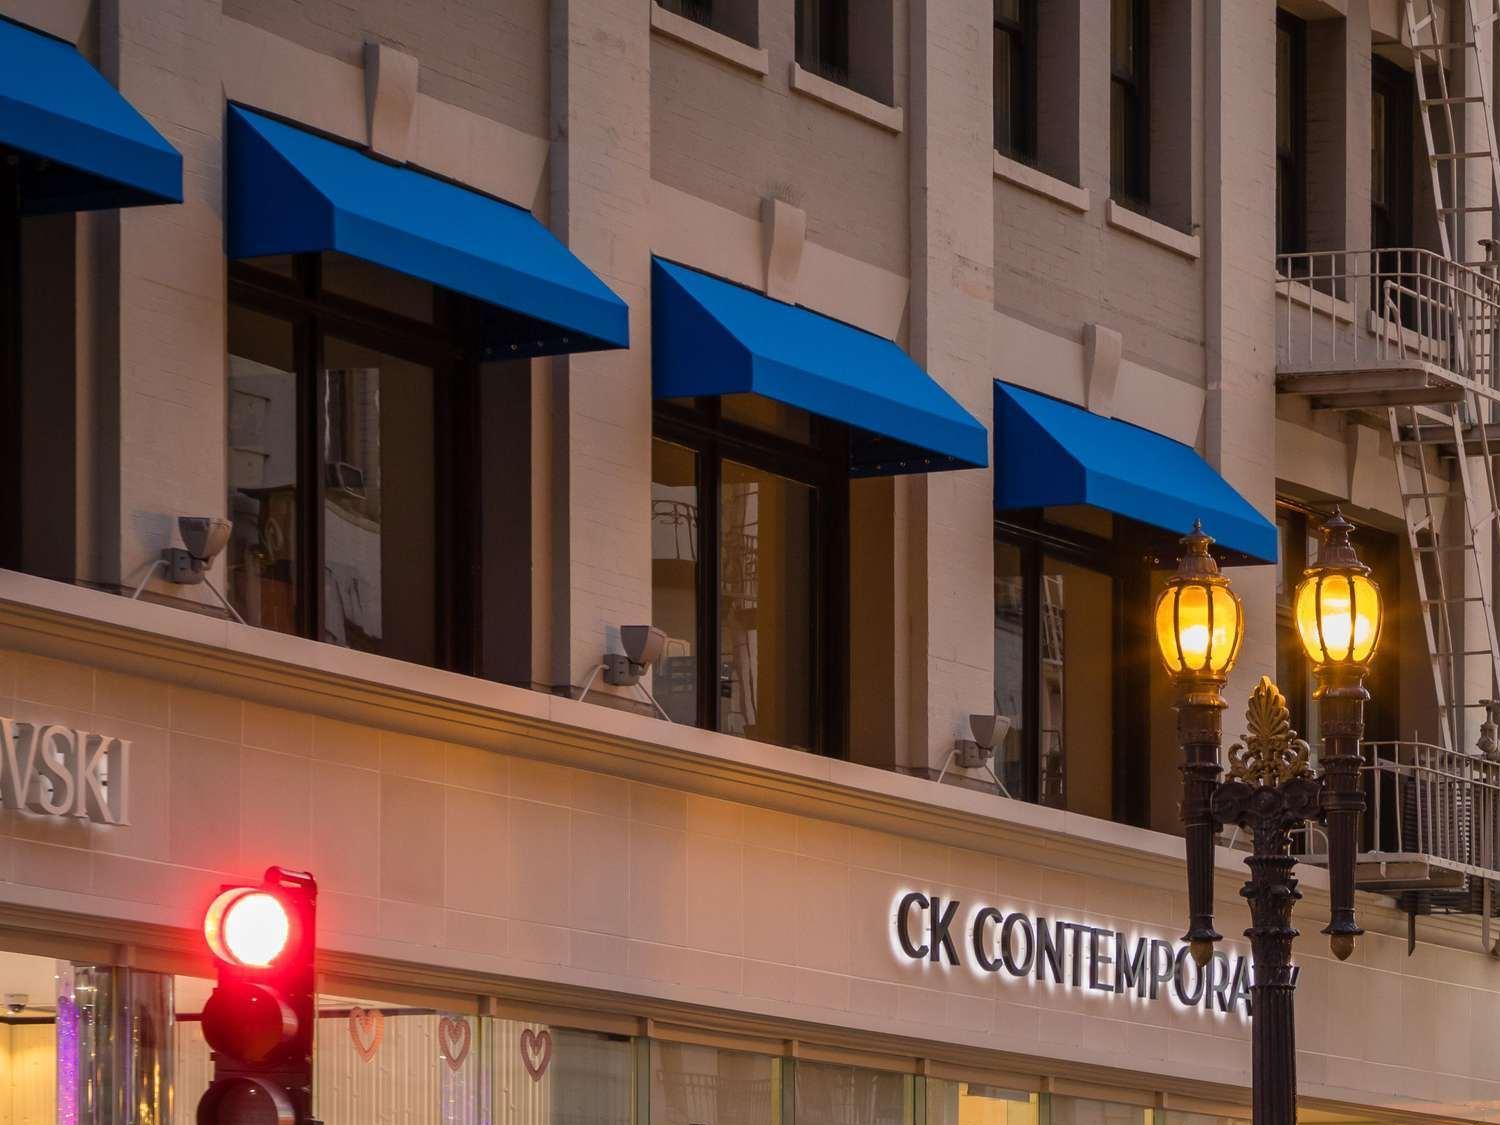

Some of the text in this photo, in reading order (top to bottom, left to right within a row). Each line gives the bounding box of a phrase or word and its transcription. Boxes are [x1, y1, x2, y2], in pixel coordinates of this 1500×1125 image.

[0, 715, 133, 827] VSKI
[897, 891, 1300, 1017] CK CONTEMPORA
